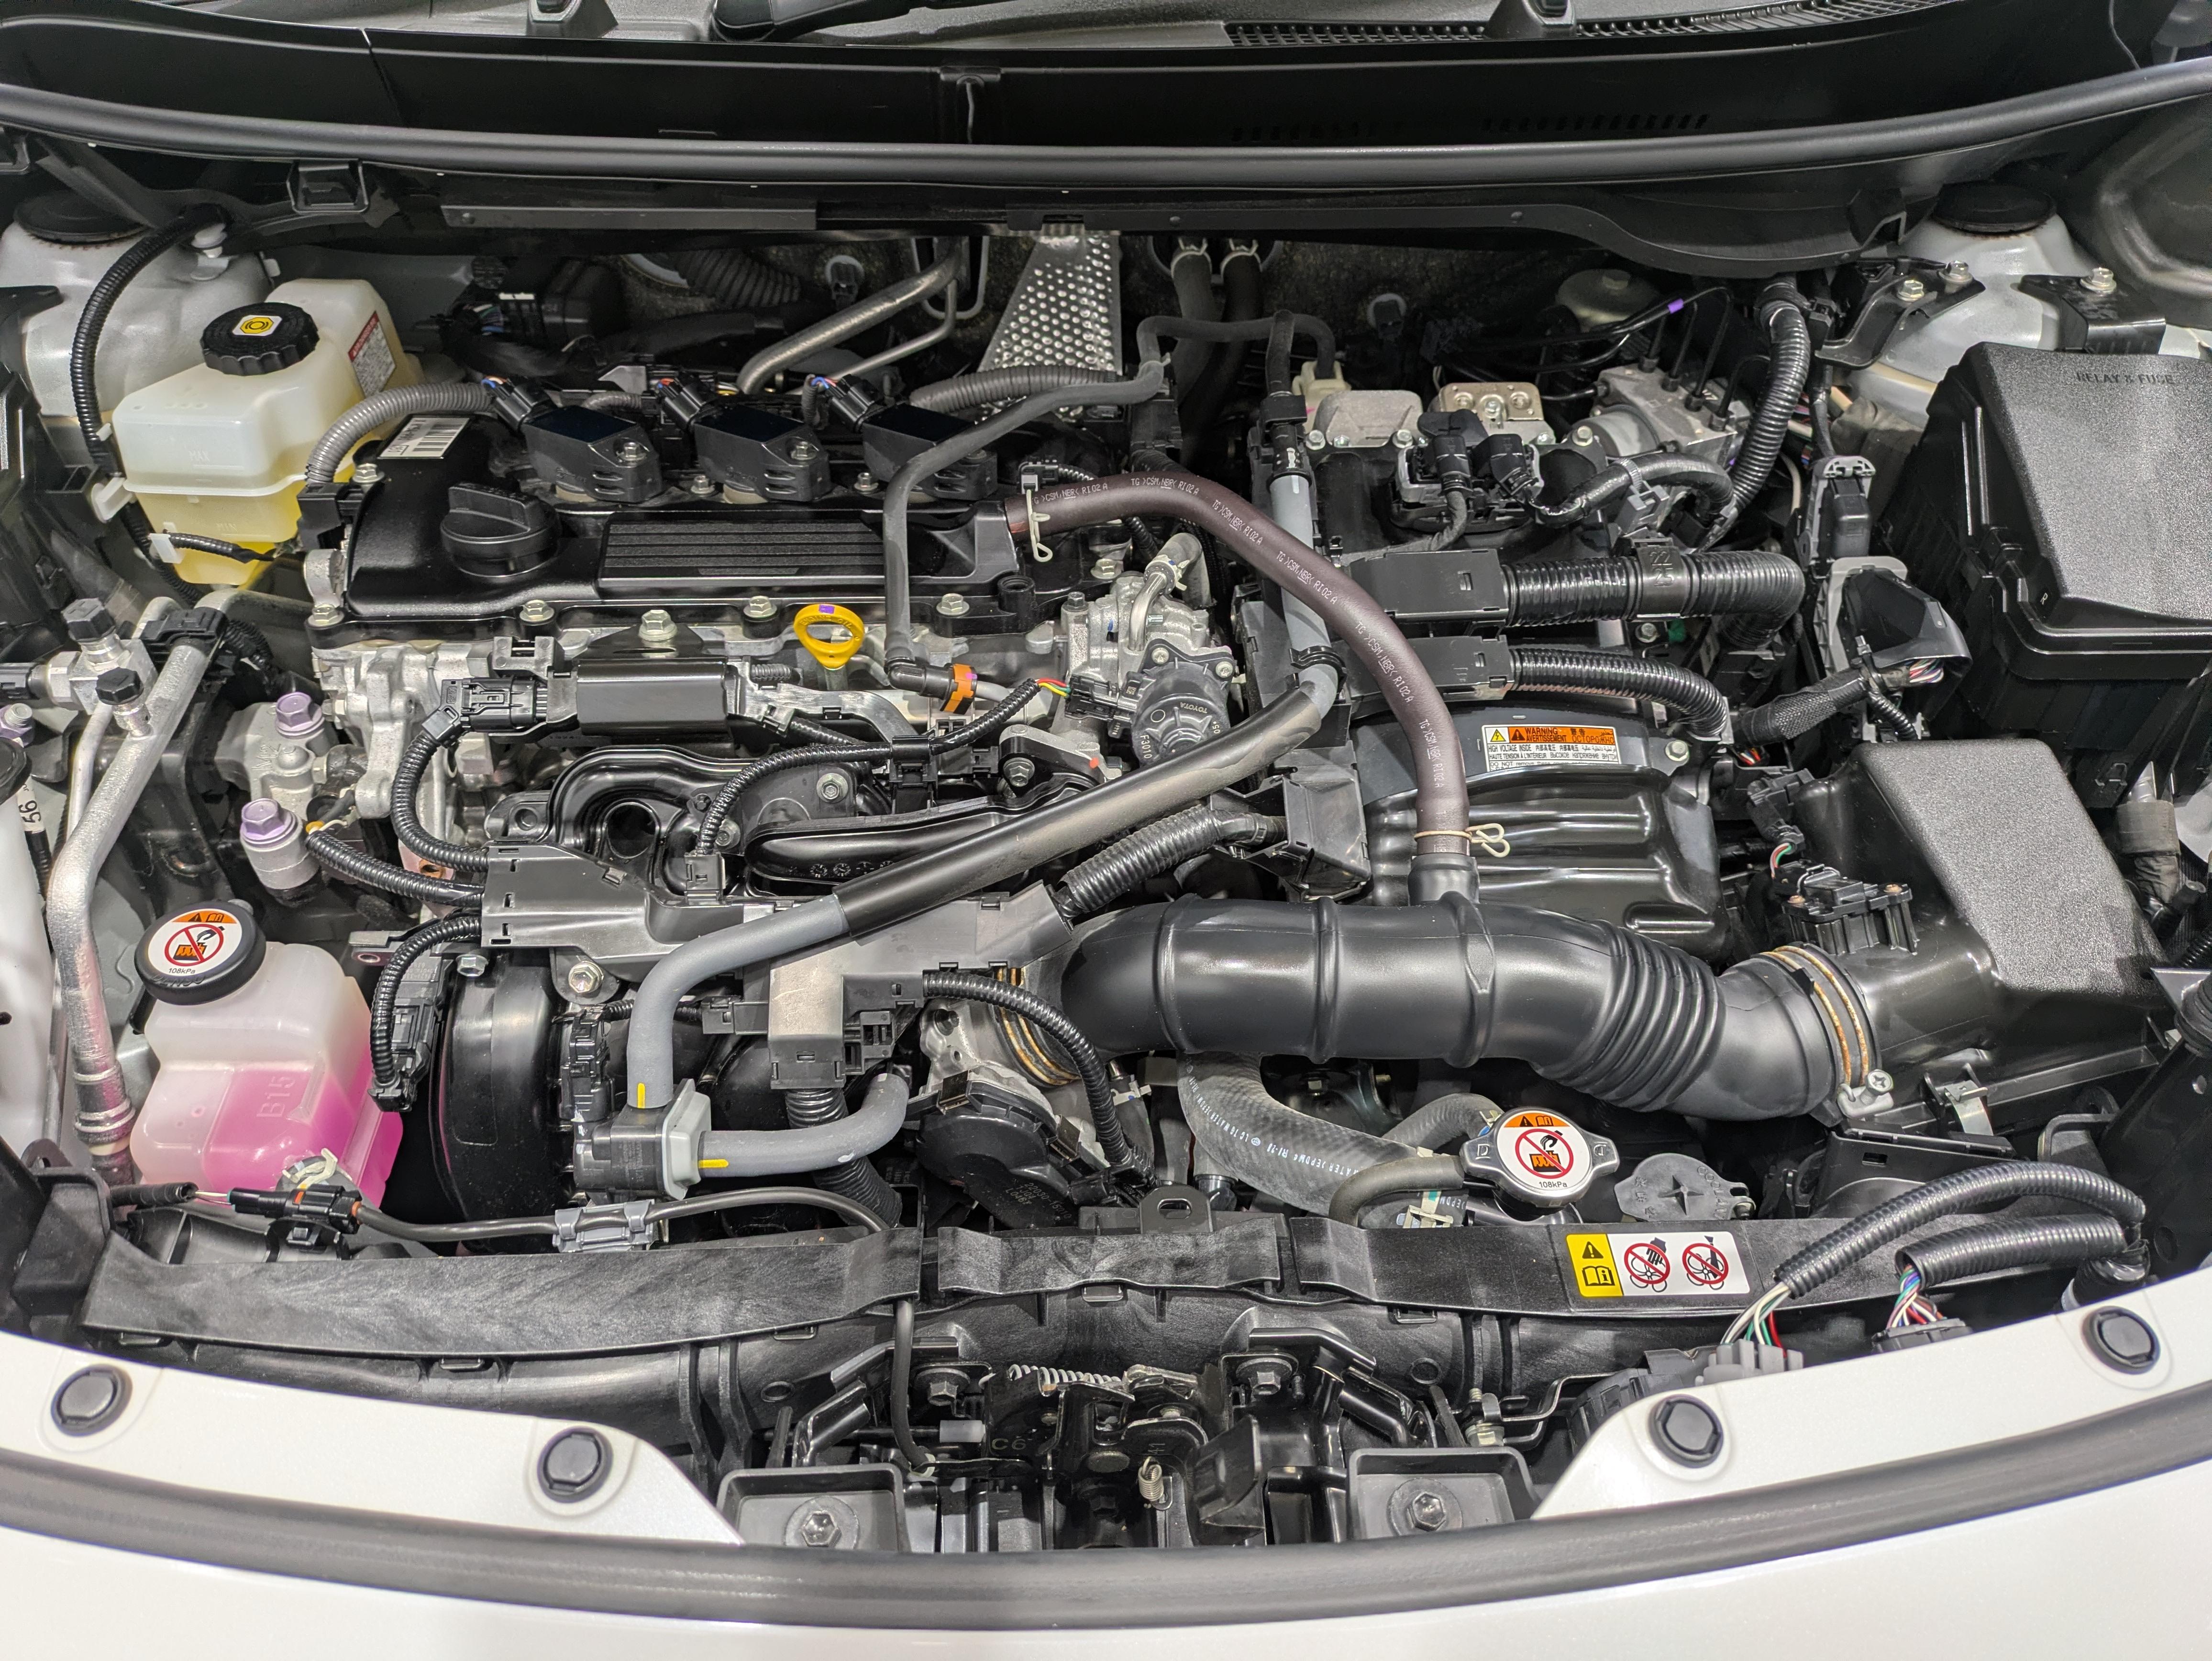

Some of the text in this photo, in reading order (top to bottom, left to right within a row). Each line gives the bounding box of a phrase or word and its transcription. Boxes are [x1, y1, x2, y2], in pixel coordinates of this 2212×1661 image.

[2076, 372, 2120, 383] RELAY
[2137, 374, 2175, 384] FUSE
[1212, 499, 1221, 510] TG
[1276, 551, 1285, 562] TG
[1355, 621, 1366, 634] TG
[1180, 702, 1208, 714] TOYOTA
[1419, 719, 1429, 729] TG
[1571, 735, 1614, 744] ОСТОРОЖНО
[1140, 735, 1152, 759] F3010
[256, 1077, 295, 1117] B15
[1697, 1166, 1727, 1219] COOLAN
